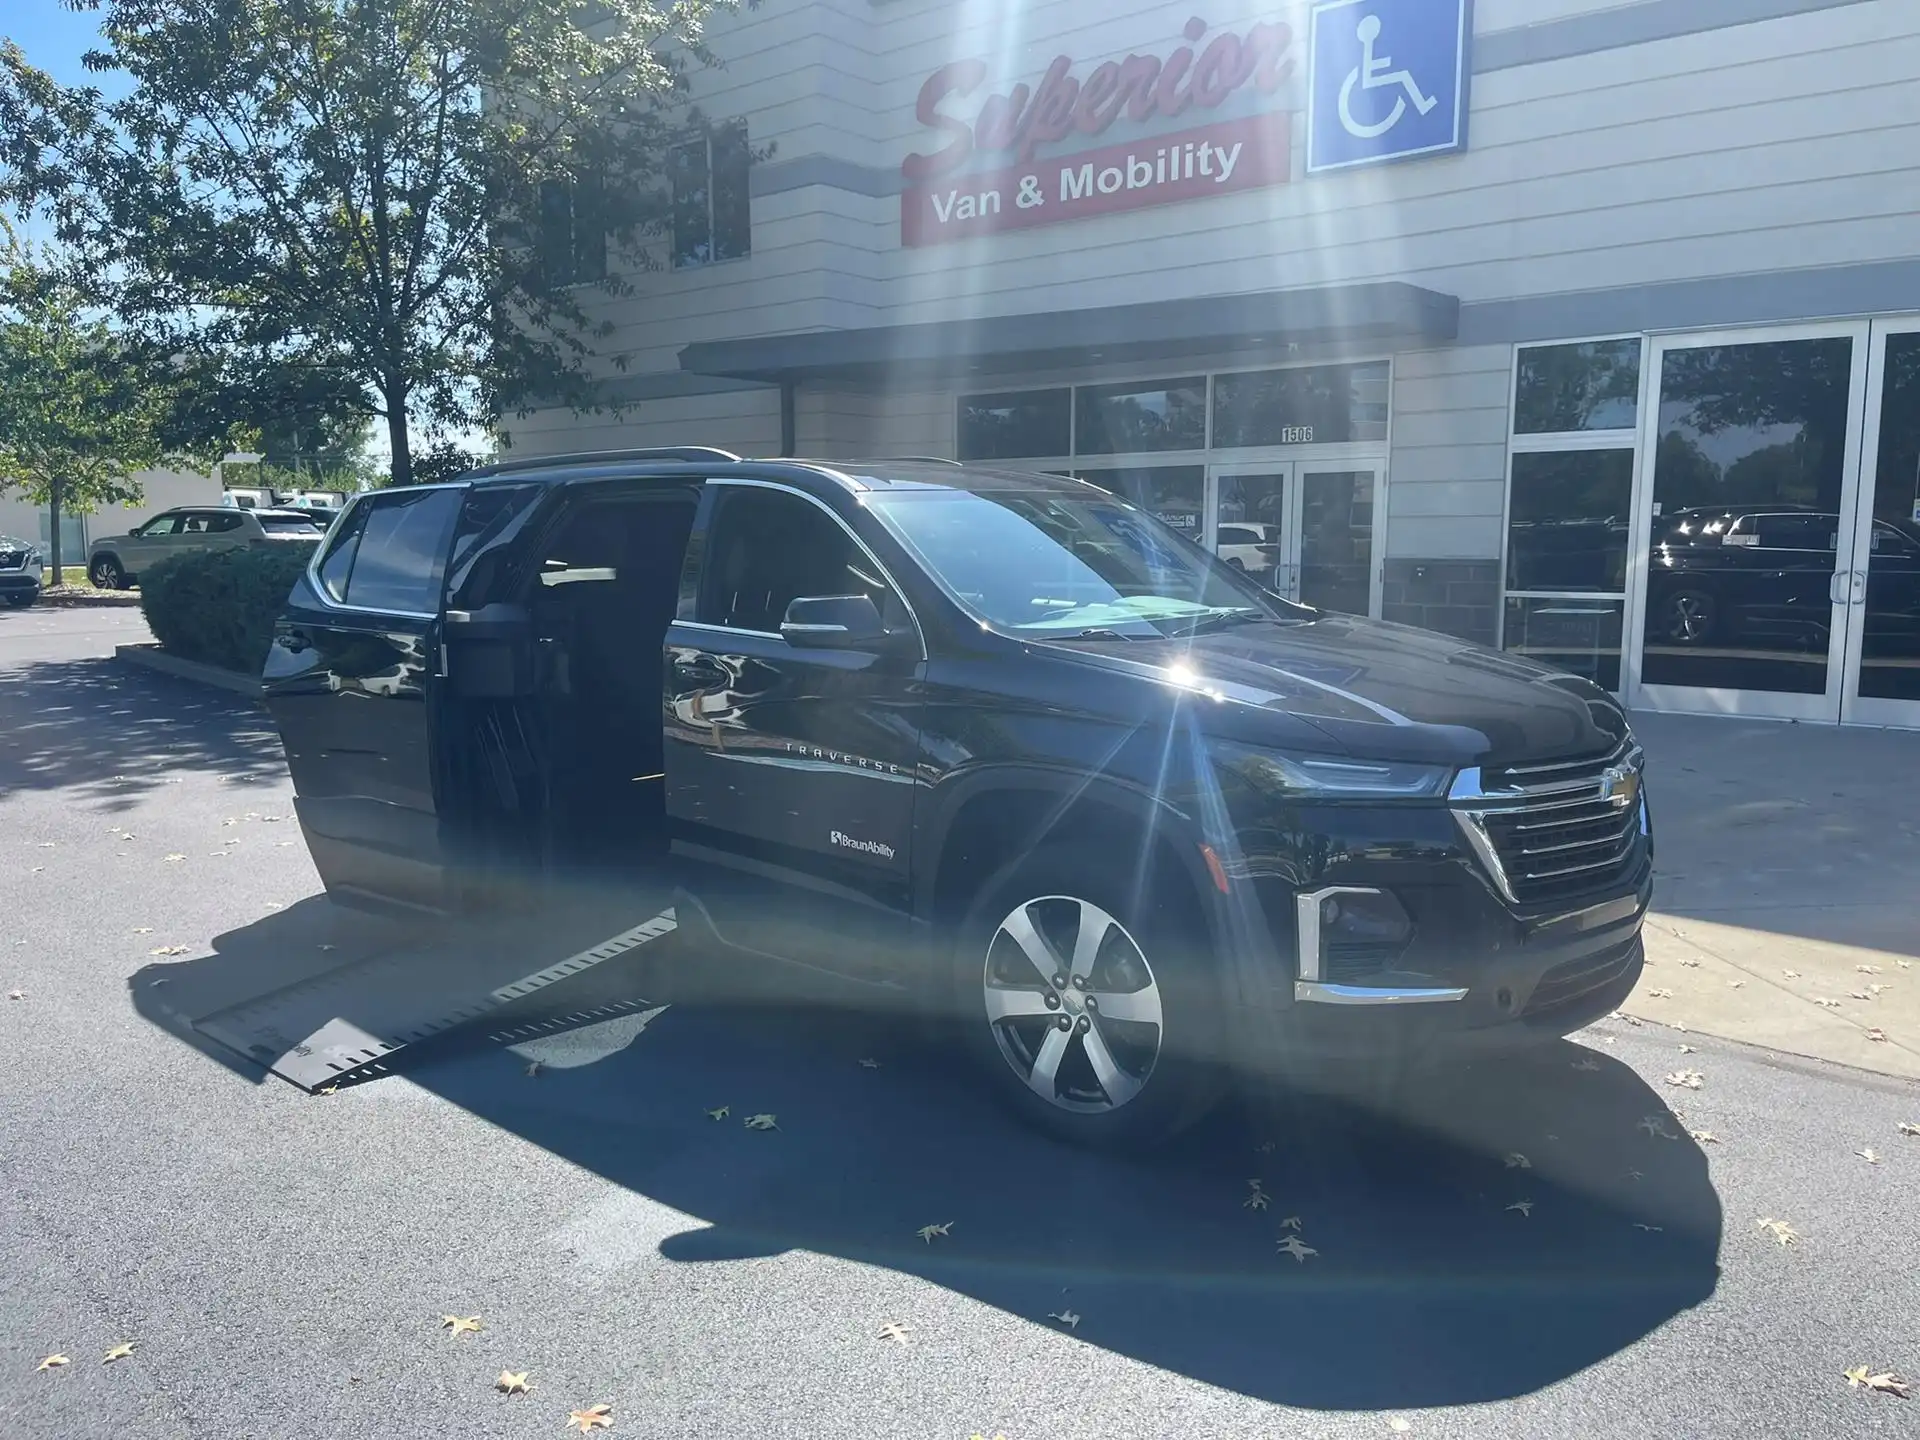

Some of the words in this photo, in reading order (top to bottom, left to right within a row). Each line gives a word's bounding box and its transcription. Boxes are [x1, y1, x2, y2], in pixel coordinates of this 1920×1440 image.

[902, 16, 1297, 178] Superior
[931, 189, 1001, 224] Van
[1015, 175, 1044, 209] &
[1060, 141, 1243, 202] Mobility
[1283, 427, 1312, 441] 1506
[786, 743, 898, 773] TRAVERSE
[842, 834, 895, 859] BraunAbility
